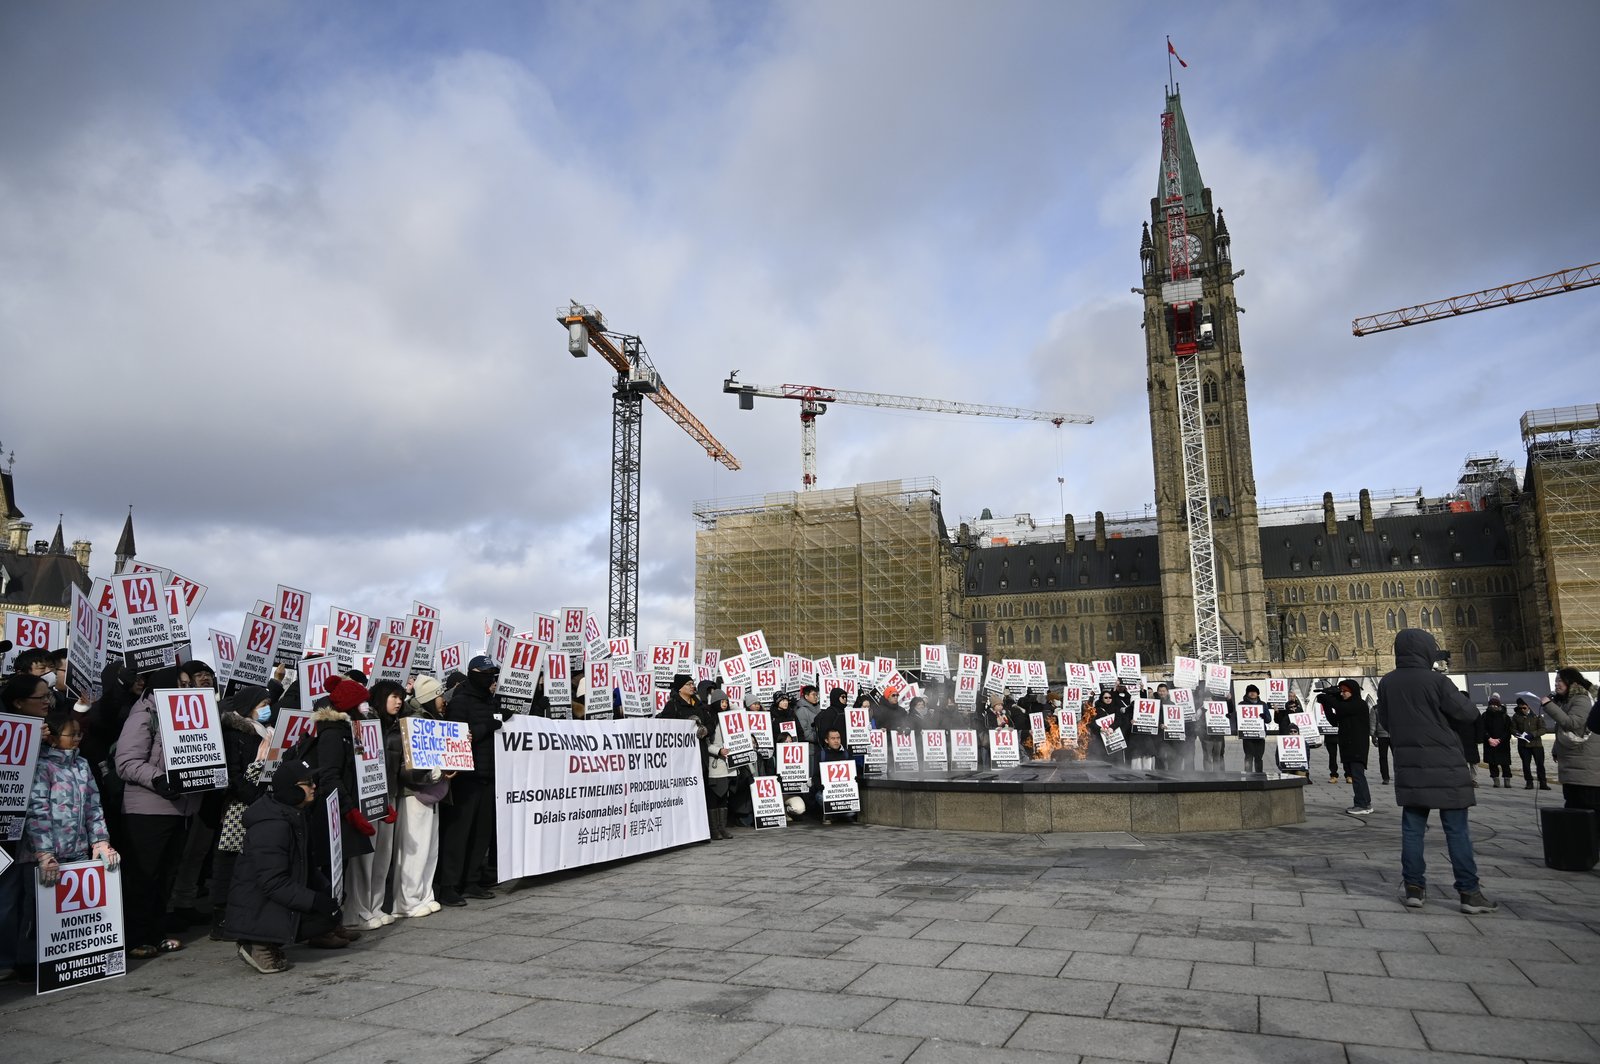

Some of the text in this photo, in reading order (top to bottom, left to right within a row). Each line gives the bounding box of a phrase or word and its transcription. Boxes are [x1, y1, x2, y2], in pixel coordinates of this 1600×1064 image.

[130, 579, 154, 612] 42
[284, 593, 301, 622] 42
[78, 598, 91, 642] 20
[133, 615, 157, 625] MONTHS
[338, 614, 359, 639] 22
[568, 610, 581, 632] 53
[20, 620, 46, 648] 36
[128, 624, 164, 637] WAITING FOR
[250, 622, 273, 654] 32
[413, 619, 430, 644] 31
[540, 618, 552, 642] 15
[126, 633, 169, 647] IRCC RESPONSE
[218, 635, 233, 660] 37
[338, 640, 356, 649] MONTHS
[612, 640, 627, 656] 20
[748, 635, 761, 651] 43
[246, 654, 265, 664] MONTHS
[332, 646, 351, 655] WAITING
[386, 640, 407, 668] 31
[442, 647, 459, 670] 28
[514, 643, 535, 670] 11
[656, 648, 672, 664] 33
[239, 661, 267, 674] WAITING FOR
[550, 656, 564, 678] 71
[727, 659, 743, 676] 30
[842, 657, 853, 669] 27
[880, 660, 892, 673] 16
[1008, 662, 1020, 674] 37
[311, 662, 329, 694] 40
[504, 678, 523, 687] WAITING
[510, 671, 529, 680] MONTHS
[593, 664, 607, 687] 53
[760, 670, 775, 686] 55
[176, 695, 204, 729] 40
[1140, 701, 1154, 714] 37
[728, 714, 742, 733] 41
[750, 714, 764, 730] 24
[851, 711, 865, 727] 34
[413, 719, 458, 737] STOP THE
[0, 722, 27, 765] 20
[179, 733, 208, 743] MONTHS
[363, 726, 377, 759] 40
[502, 732, 696, 752] WE DEMAND A TIMELY DECISION
[998, 732, 1012, 746] 14
[1285, 738, 1300, 749] 22
[173, 743, 216, 754] WAITING FOR
[785, 746, 801, 763] 40
[170, 753, 221, 766] IRCC RESPONSE
[569, 752, 667, 773] DELAYED BY IRCC
[0, 771, 20, 781] NTHS
[192, 777, 216, 786] RESULTS
[830, 765, 848, 782] 22
[10, 784, 24, 794] FOR
[506, 776, 698, 804] REASONABLE TIMELINES PROCEDURAL FAIRNESS
[759, 780, 774, 797] 43
[534, 796, 684, 825] Délais raisonnables Équité procédurale
[578, 816, 663, 845] 给出时限 程序公平
[61, 867, 101, 912] 20
[61, 912, 102, 928] MONTHS
[50, 923, 112, 942] WAITING FOR
[45, 934, 118, 957] IRCC RESPONSE
[55, 962, 67, 972] NO
[58, 964, 107, 982] NO RESULTS
